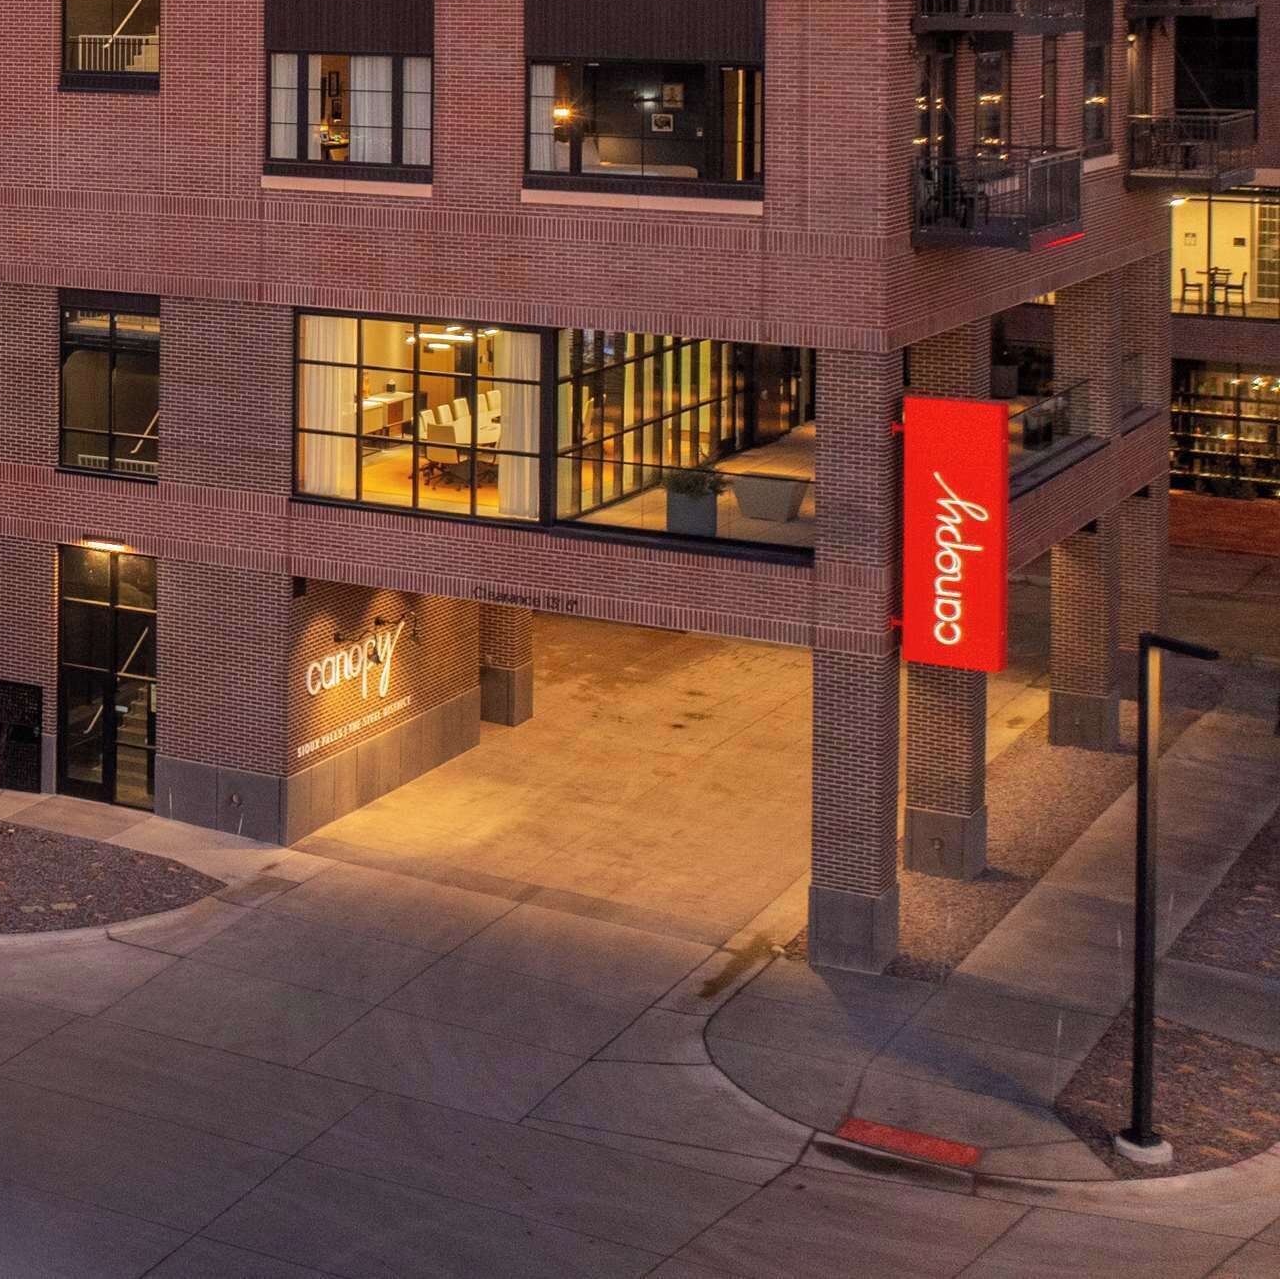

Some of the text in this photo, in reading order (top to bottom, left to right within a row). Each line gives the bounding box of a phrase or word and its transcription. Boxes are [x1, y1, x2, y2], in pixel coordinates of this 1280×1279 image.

[933, 471, 990, 645] canopy
[473, 586, 541, 609] Clearance
[306, 620, 405, 700] canopy
[297, 739, 320, 758] SIOUX
[320, 728, 343, 747] FALLS
